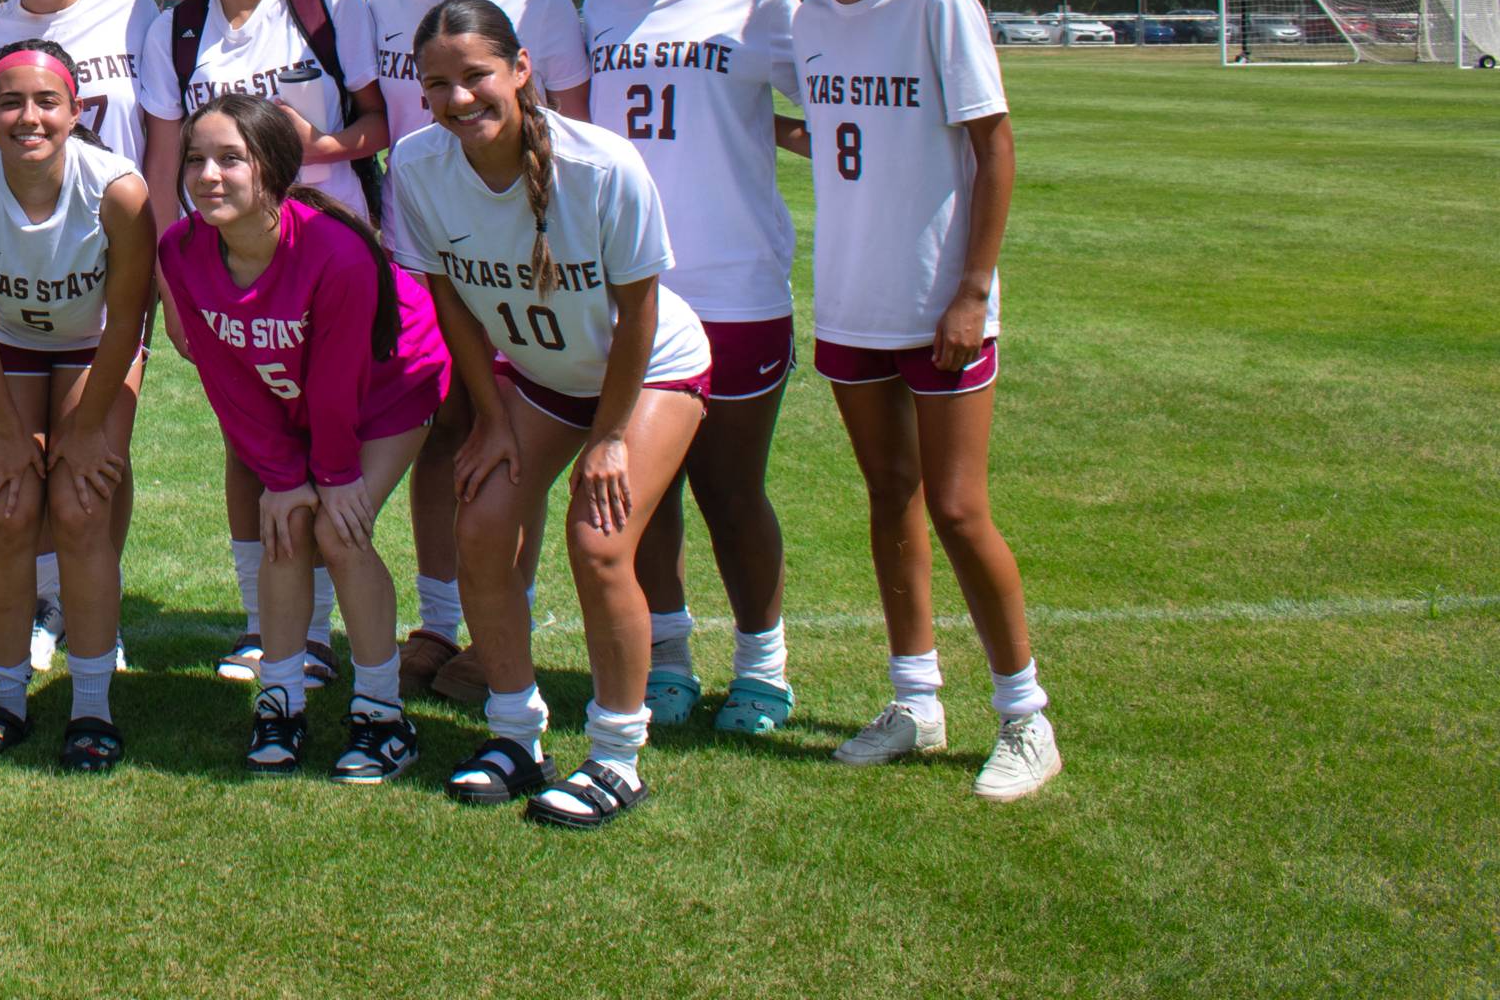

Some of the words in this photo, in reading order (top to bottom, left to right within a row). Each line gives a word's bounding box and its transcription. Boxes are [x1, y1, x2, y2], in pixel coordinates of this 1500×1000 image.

[76, 54, 138, 84] STATE
[379, 49, 420, 80] EXA
[591, 43, 646, 74] EXAS
[654, 41, 733, 75] STATE
[806, 75, 844, 104] XAS
[850, 75, 921, 108] STATE
[626, 83, 676, 140] 21
[836, 122, 861, 181] 8
[438, 250, 511, 289] TEXAS
[516, 260, 602, 292] SATE
[21, 309, 55, 332] 5
[496, 301, 566, 351] 10
[254, 362, 301, 400] 5
